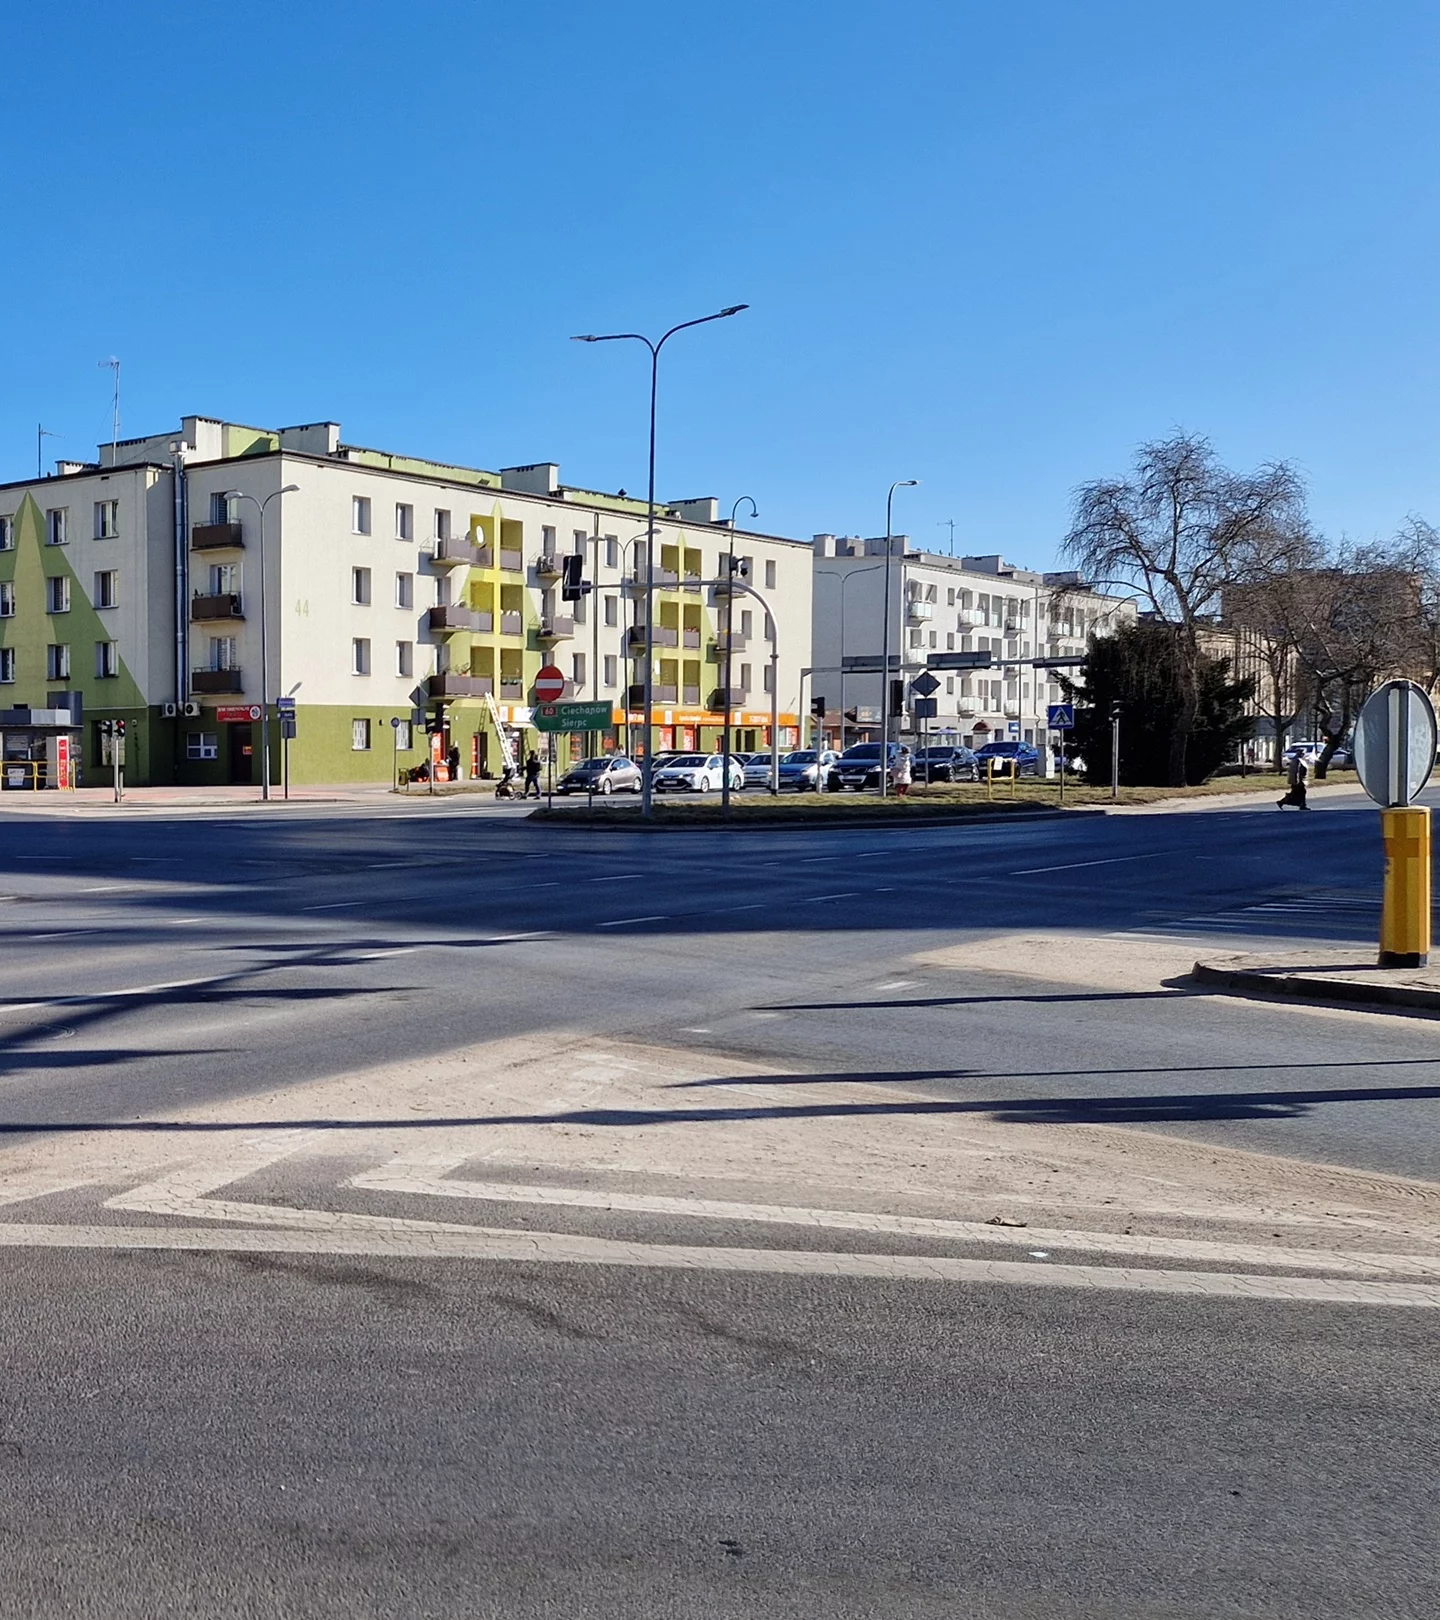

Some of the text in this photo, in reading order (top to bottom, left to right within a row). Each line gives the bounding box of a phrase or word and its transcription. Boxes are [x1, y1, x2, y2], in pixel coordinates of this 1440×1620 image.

[295, 599, 309, 617] 44
[545, 707, 554, 715] 60
[561, 706, 607, 715] Ciechanów
[561, 718, 588, 728] Sierpc
